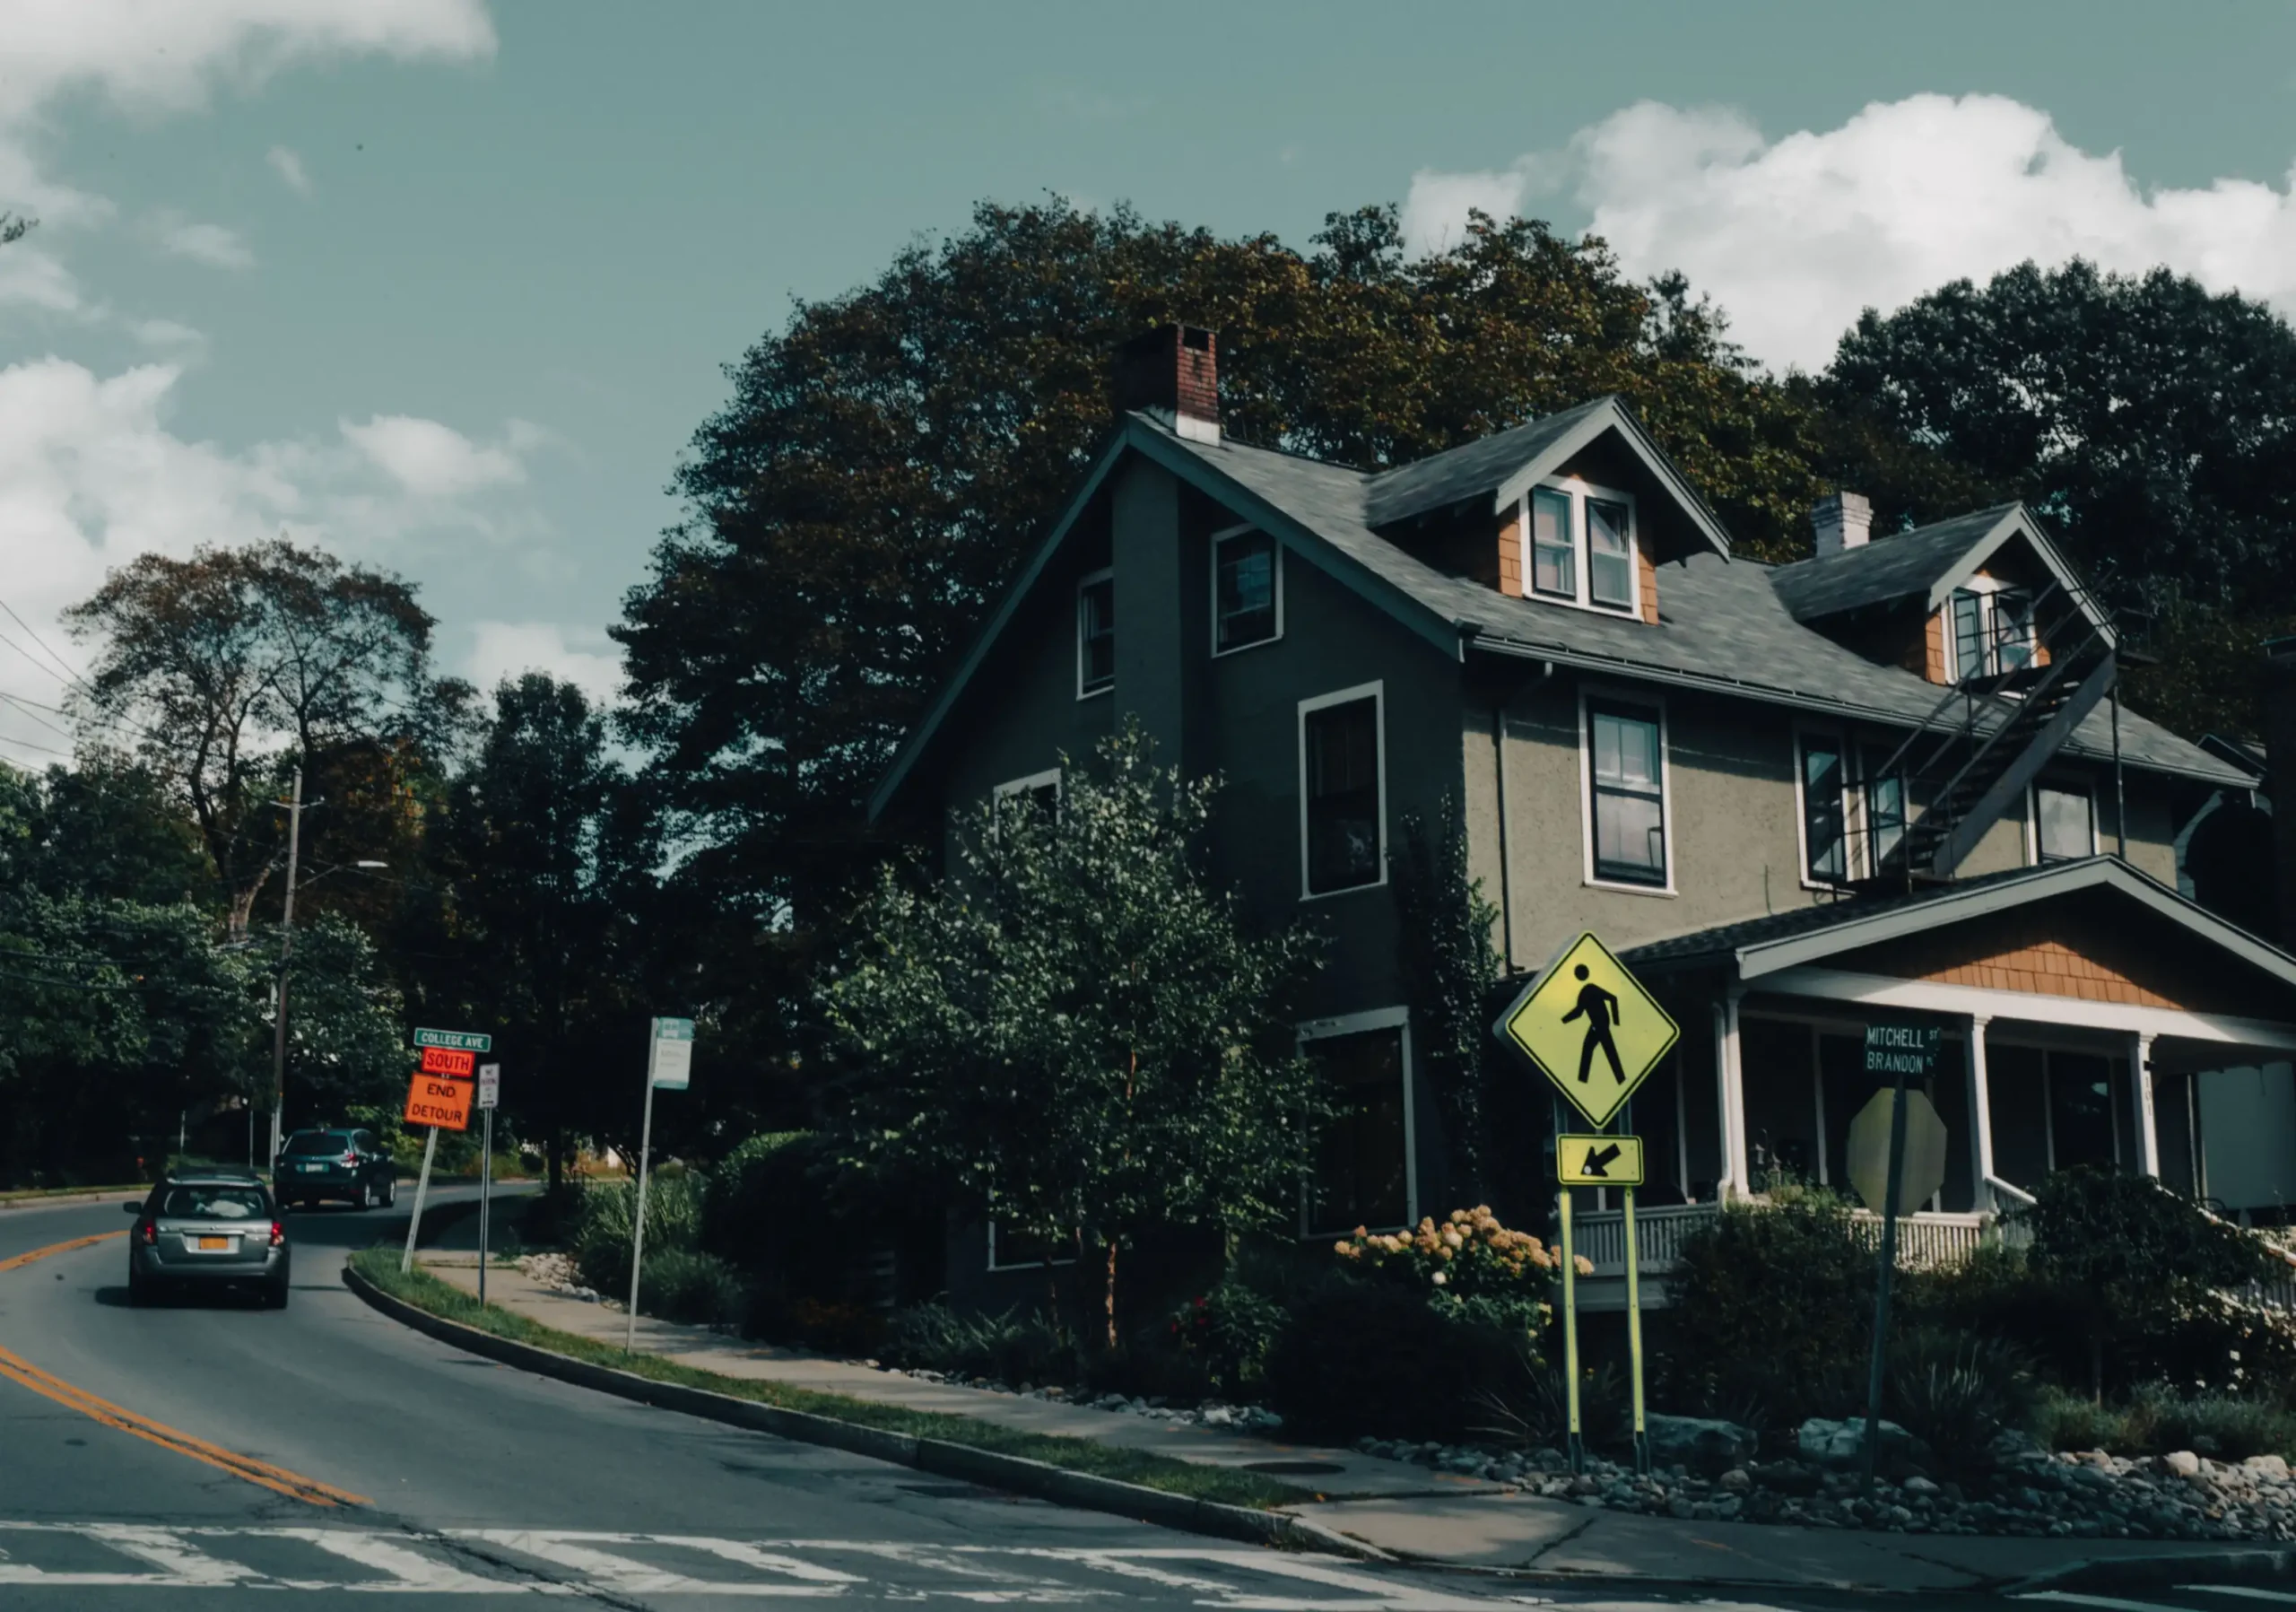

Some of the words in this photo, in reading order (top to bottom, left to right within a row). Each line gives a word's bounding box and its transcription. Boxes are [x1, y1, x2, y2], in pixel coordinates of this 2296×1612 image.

[422, 1033, 463, 1047] COLLEGE
[466, 1036, 483, 1049] AVE
[1866, 1026, 1924, 1048] MITCHELL
[426, 1051, 469, 1071] SOUTH
[1866, 1051, 1923, 1074] BRANDON
[427, 1083, 456, 1098] END
[412, 1103, 463, 1122] DETOUR
